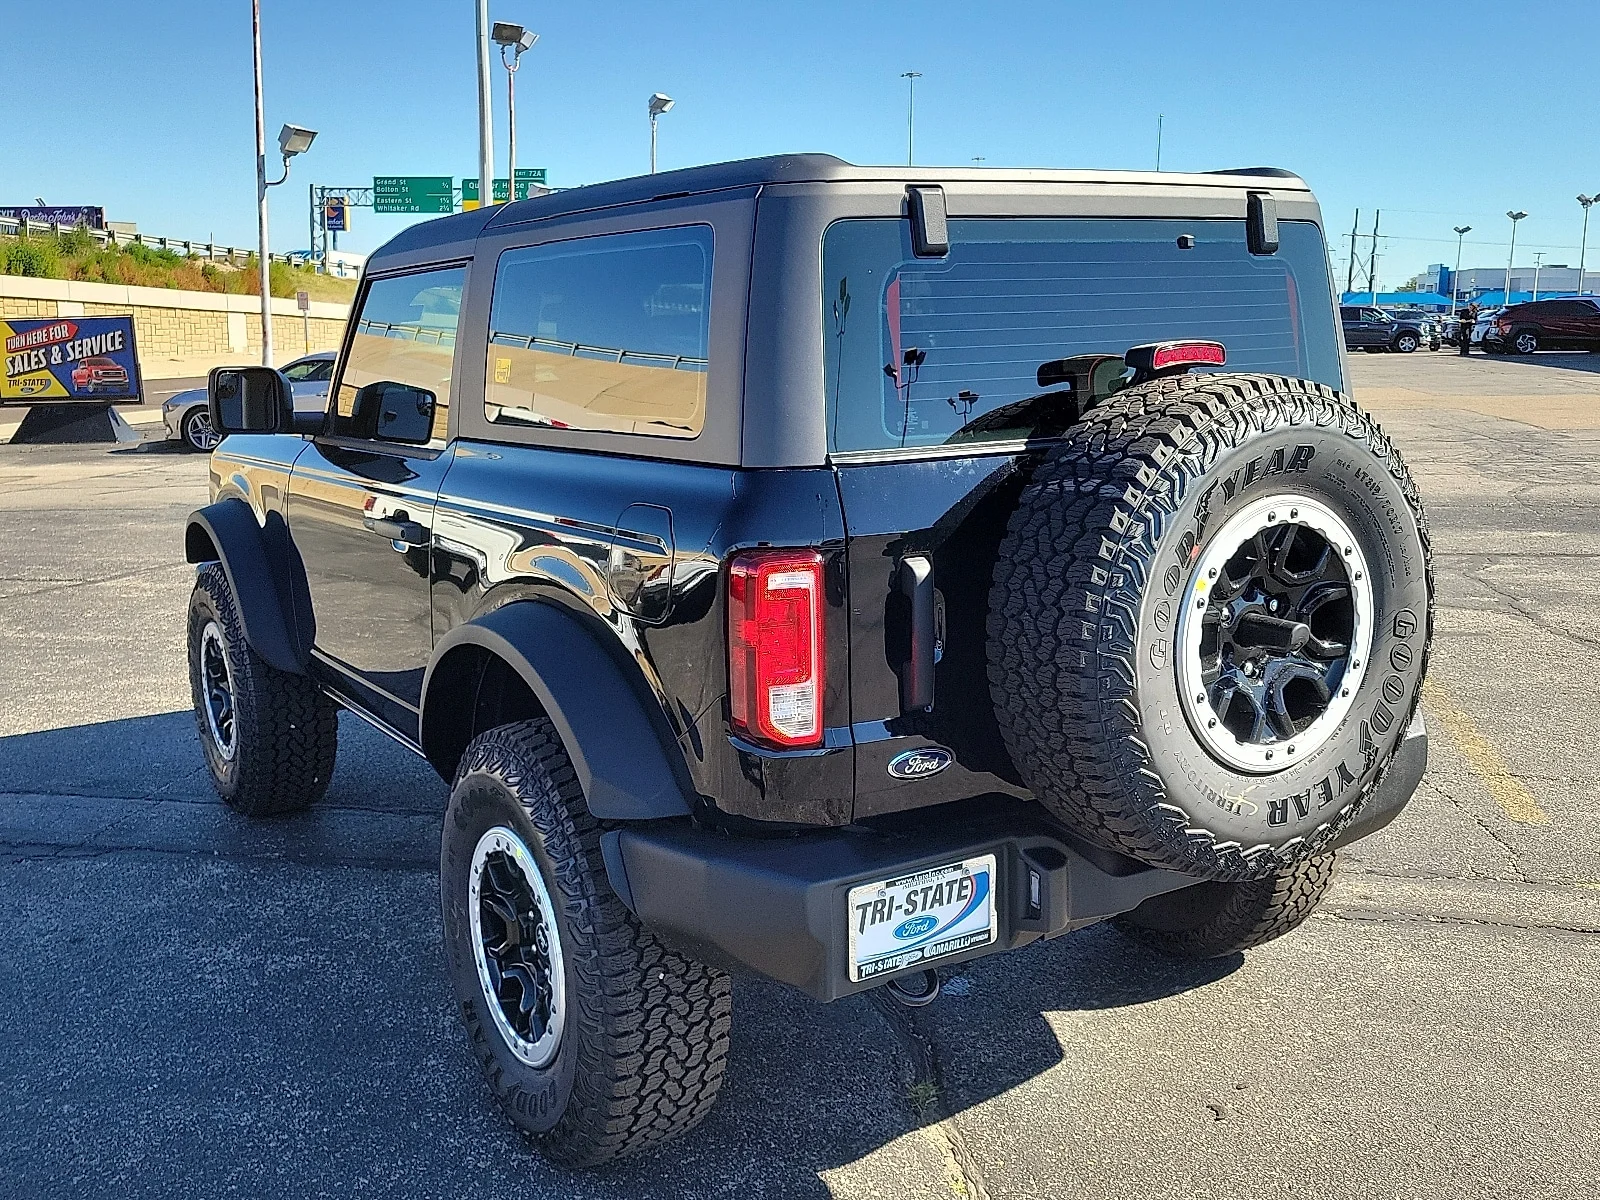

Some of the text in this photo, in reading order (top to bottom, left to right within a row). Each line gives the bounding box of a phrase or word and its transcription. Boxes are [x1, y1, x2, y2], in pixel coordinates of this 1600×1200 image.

[7, 323, 70, 351] TURN HERE FOR
[5, 330, 124, 376] SALES & SERVICE
[904, 754, 940, 774] Ford
[855, 877, 974, 935] TRI-STATE
[902, 920, 930, 937] Ford
[860, 955, 902, 978] TRI-STATE
